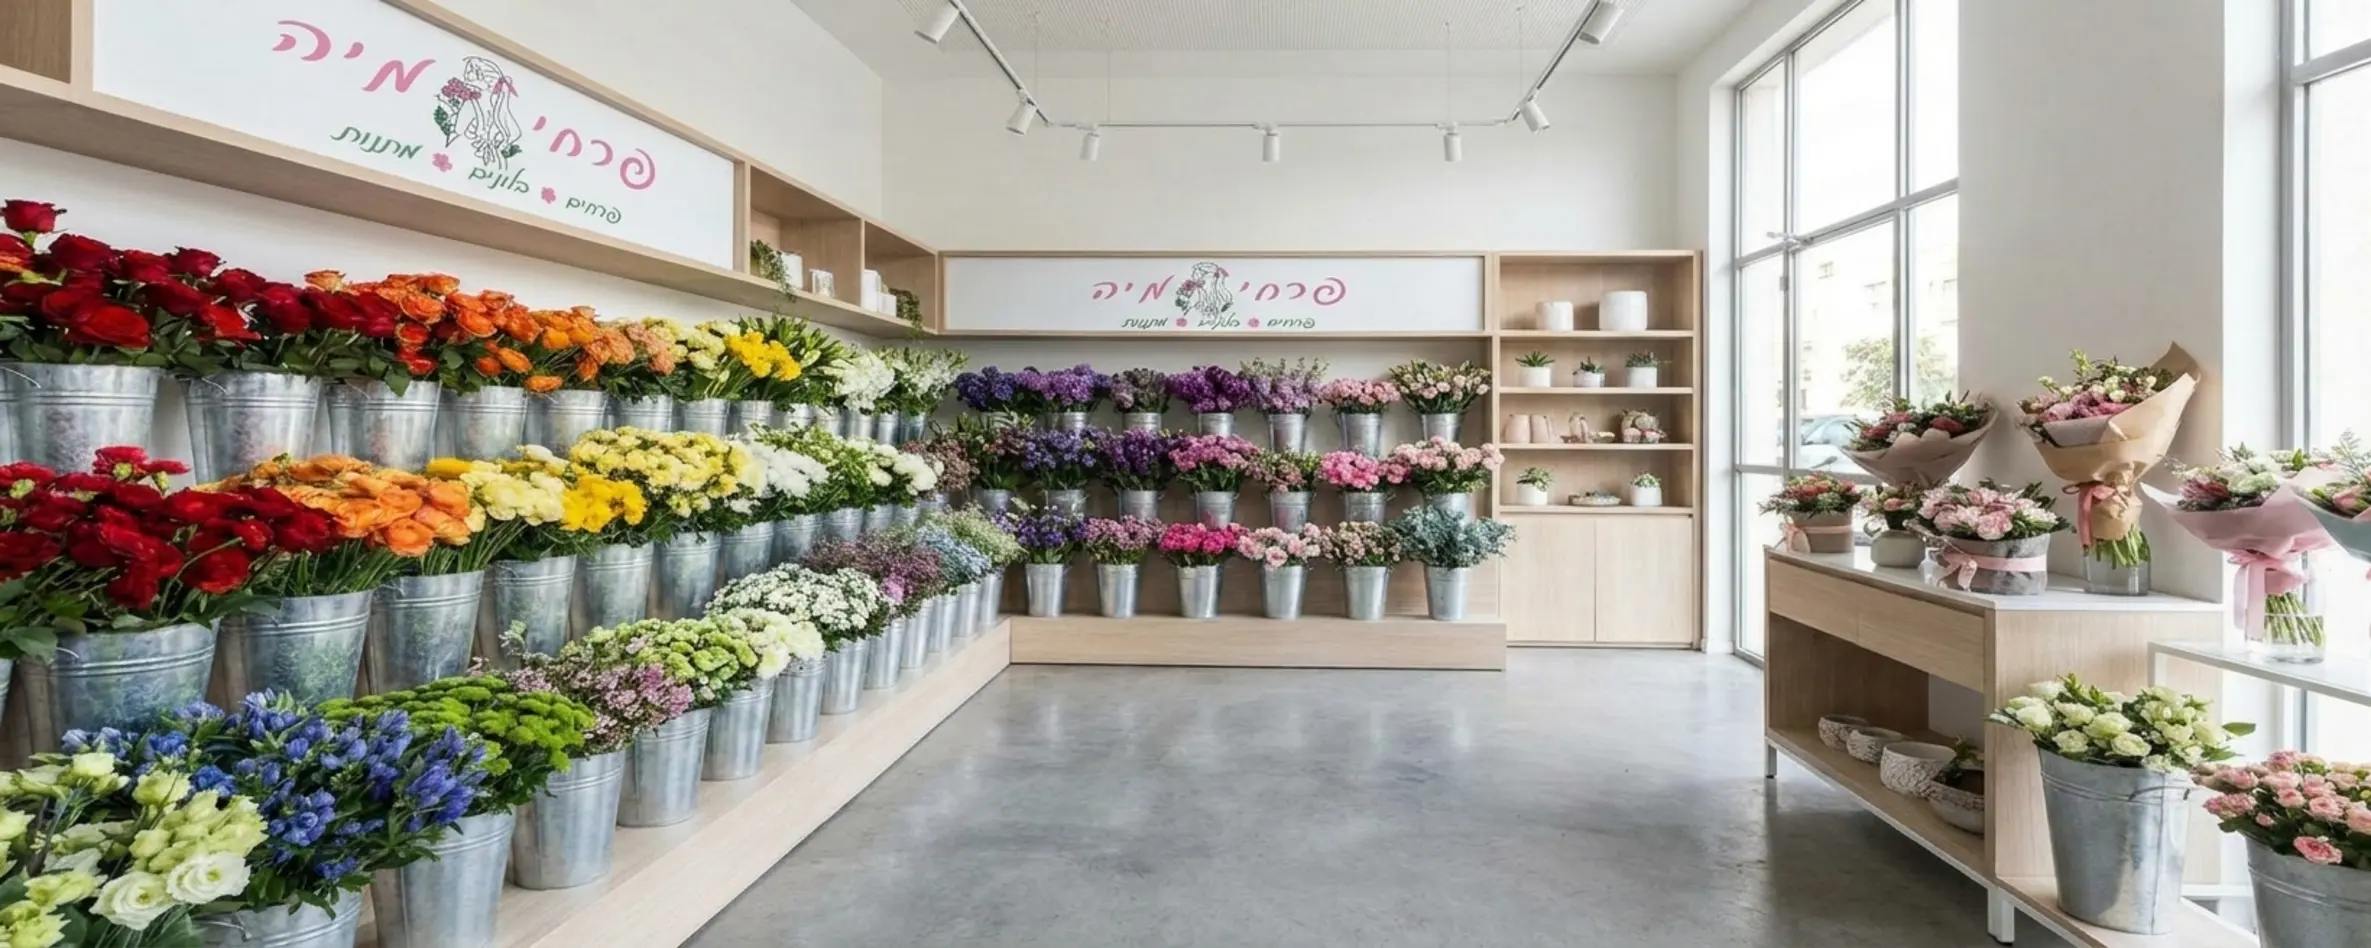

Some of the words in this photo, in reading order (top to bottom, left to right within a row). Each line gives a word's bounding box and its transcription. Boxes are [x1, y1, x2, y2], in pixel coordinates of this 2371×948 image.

[273, 20, 436, 93] מיה
[330, 126, 423, 160] מתנות
[532, 115, 656, 190] פרחי
[468, 168, 530, 194] בלונים
[565, 196, 622, 225] פרחים
[1092, 275, 1175, 303] מיה
[1240, 277, 1346, 306] פרחי
